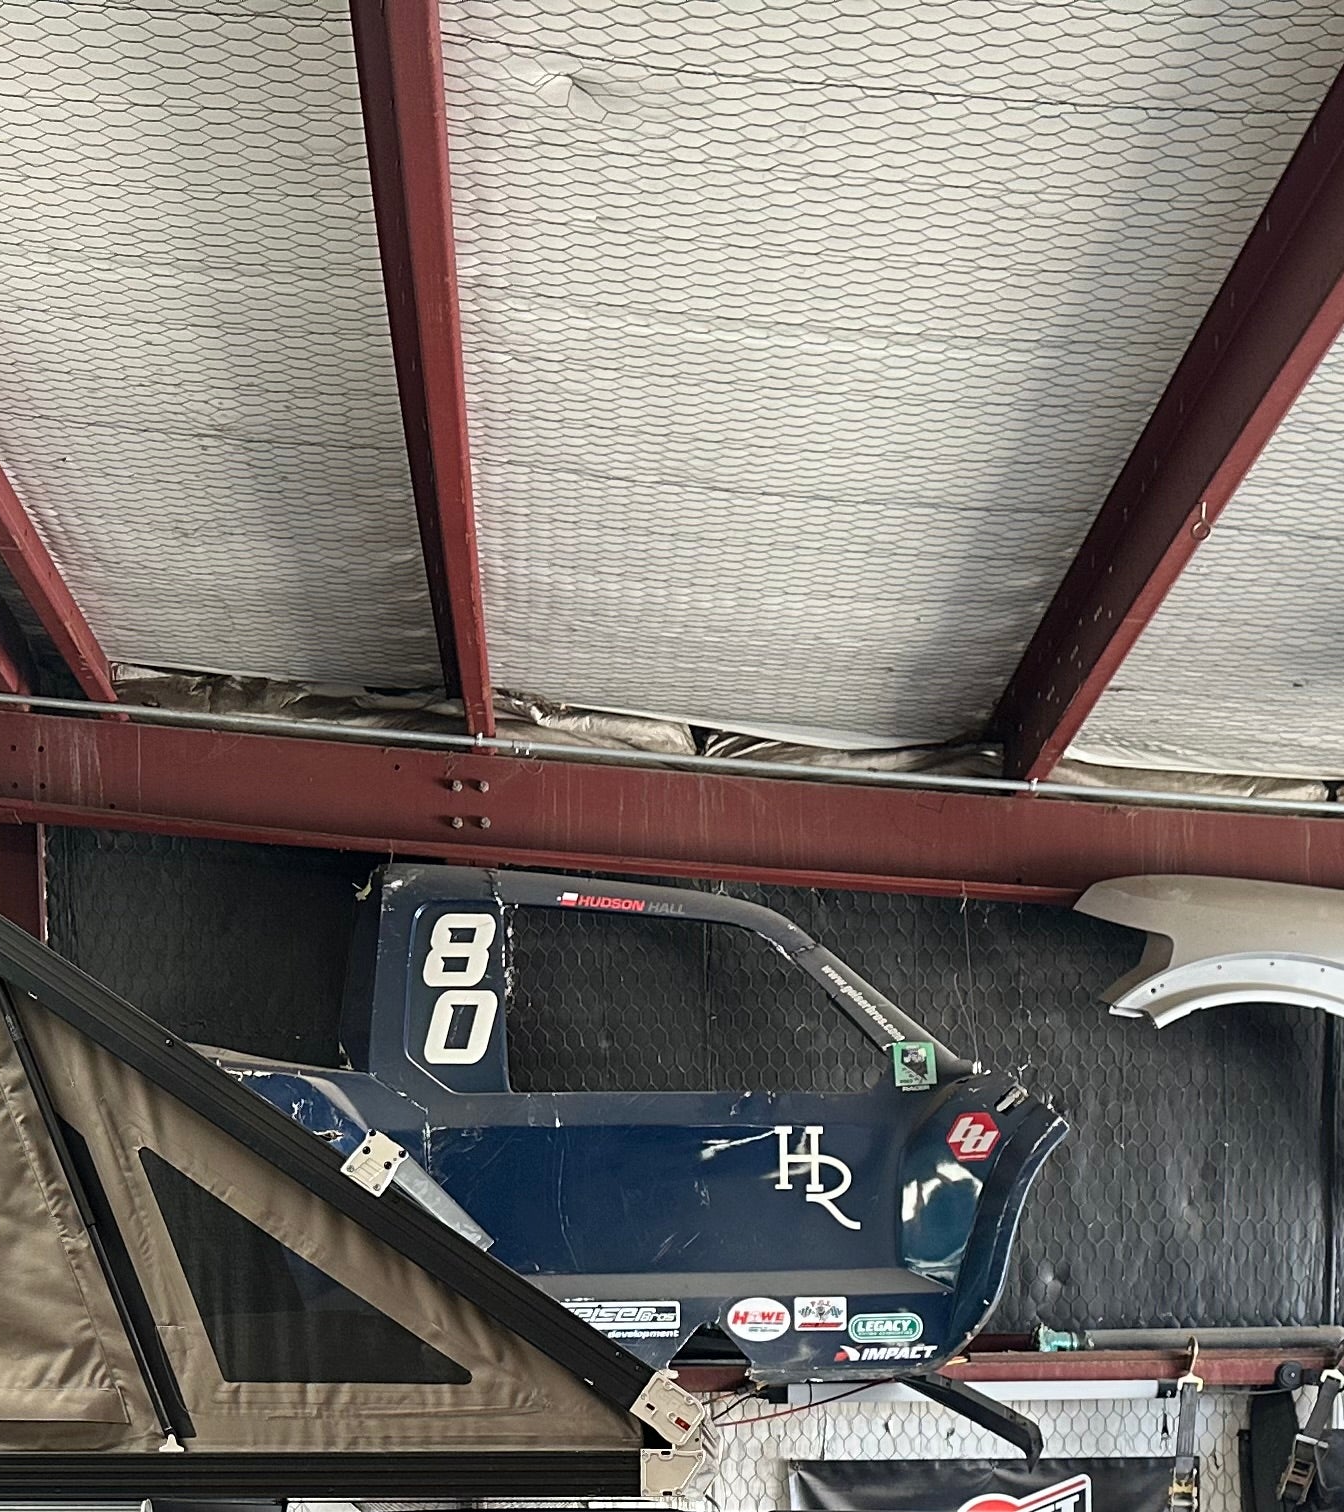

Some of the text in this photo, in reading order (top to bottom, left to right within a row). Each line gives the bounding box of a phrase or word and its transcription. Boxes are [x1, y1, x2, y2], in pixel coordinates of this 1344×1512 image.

[578, 895, 686, 915] HUDSON HALL
[568, 1307, 646, 1323] eiser
[857, 1320, 911, 1333] LEGACY
[607, 1329, 680, 1340] development
[861, 1345, 938, 1360] IMPACT
